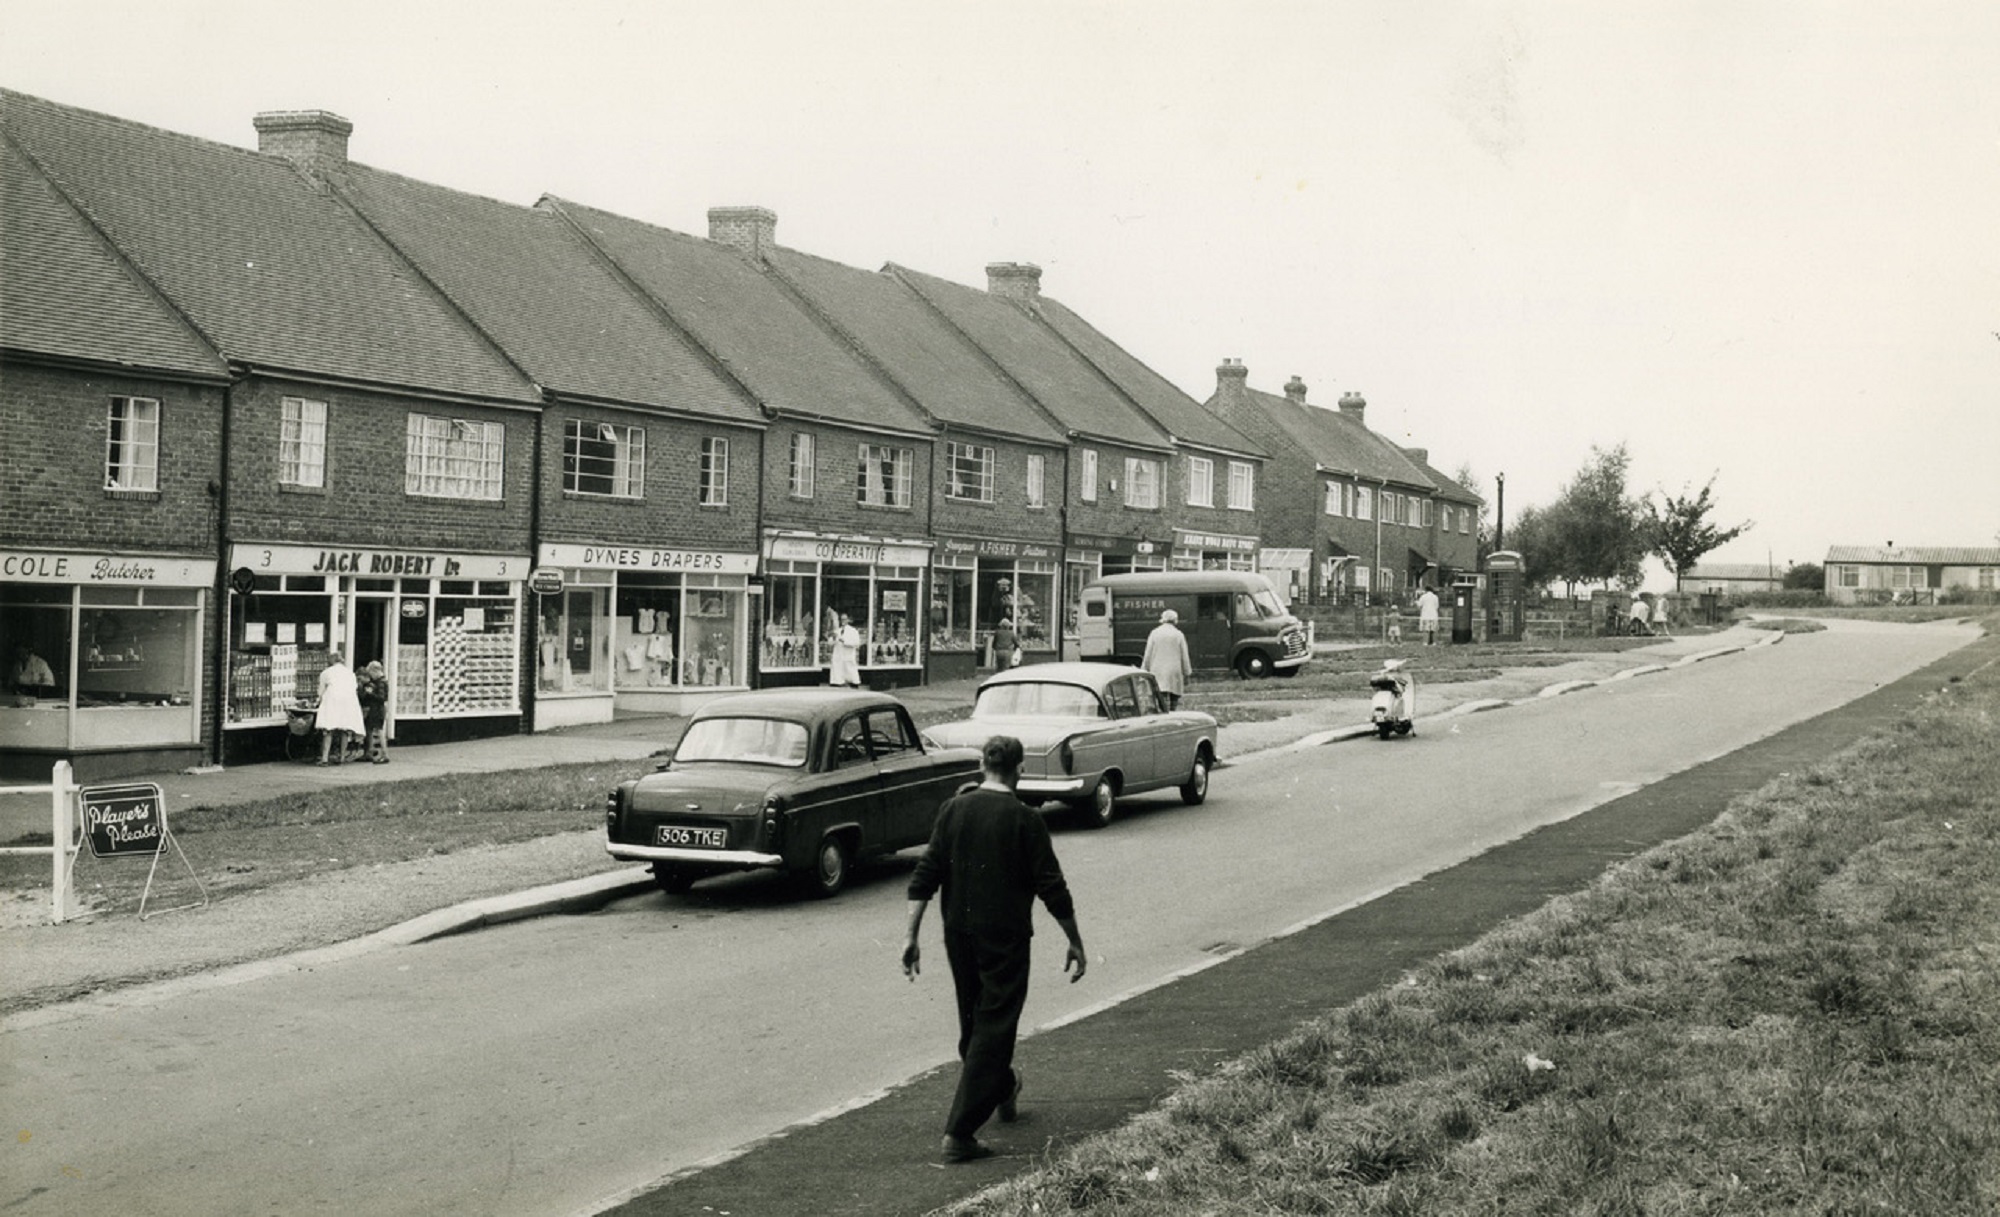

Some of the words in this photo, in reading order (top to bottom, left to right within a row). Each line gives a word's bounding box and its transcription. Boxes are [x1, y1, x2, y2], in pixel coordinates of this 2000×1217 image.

[261, 550, 273, 567] 3
[313, 551, 361, 572] JACK
[370, 554, 436, 575] ROBERT
[497, 561, 507, 576] 3
[584, 547, 641, 566] DYNES
[651, 551, 723, 569] DRAPERS
[91, 559, 156, 580] Butcher
[1124, 599, 1165, 609] FISHER
[88, 803, 150, 834] Player's
[106, 824, 157, 850] Please
[661, 828, 689, 844] 506
[693, 830, 722, 846] TKE
